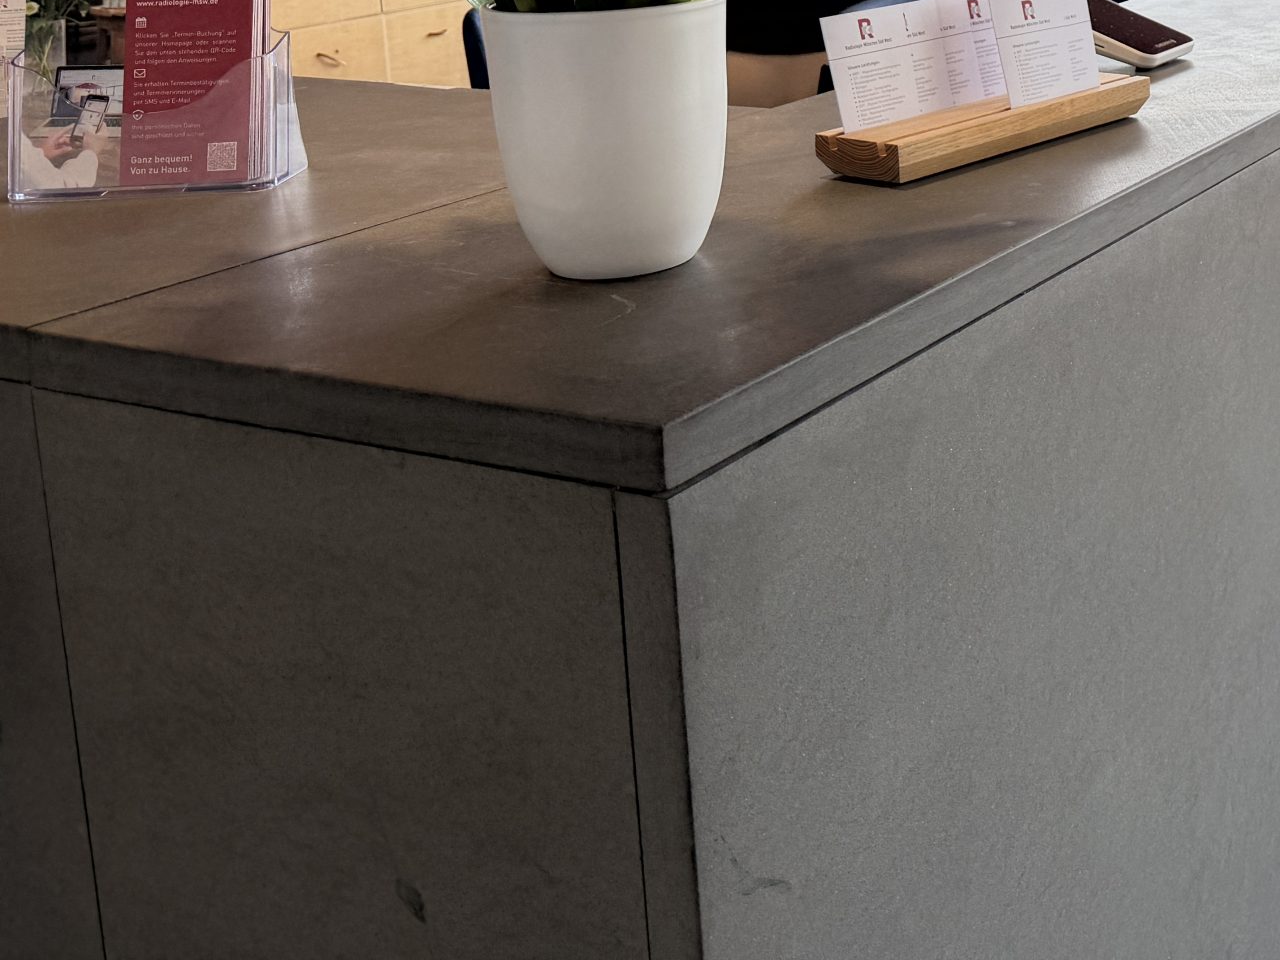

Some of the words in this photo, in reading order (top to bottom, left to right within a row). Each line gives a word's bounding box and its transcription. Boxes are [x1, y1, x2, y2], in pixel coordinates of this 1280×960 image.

[130, 155, 152, 164] Ganz
[154, 154, 193, 165] bequem!
[130, 166, 147, 175] Von
